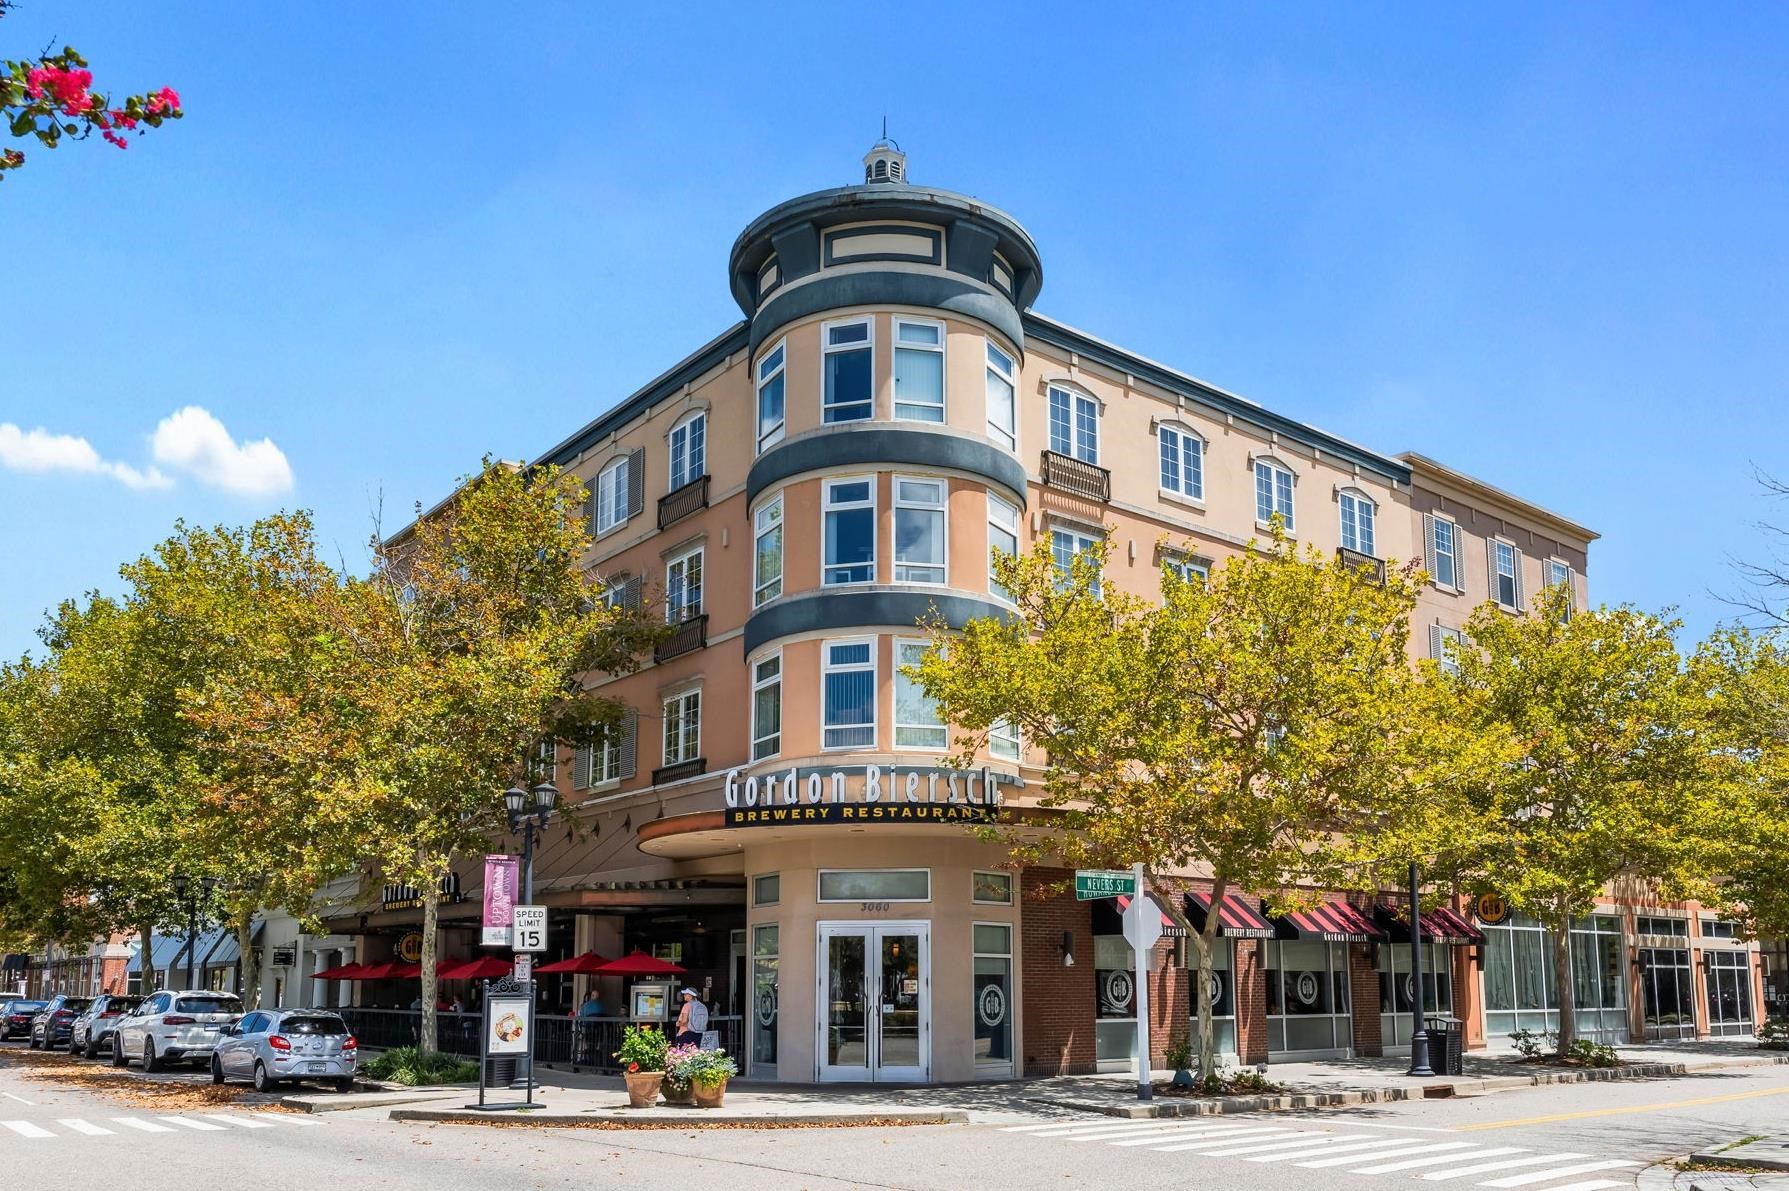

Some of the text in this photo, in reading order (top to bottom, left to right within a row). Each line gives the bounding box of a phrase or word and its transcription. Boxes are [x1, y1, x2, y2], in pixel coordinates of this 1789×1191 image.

[725, 763, 998, 807] Gordon Biersch
[735, 806, 987, 822] BREWERY RESTAURANT
[1087, 878, 1125, 891] NEVERS ST
[492, 866, 504, 924] UPTOWN
[860, 903, 890, 912] 3060
[518, 919, 541, 927] LIMIT
[520, 931, 540, 947] 15
[1224, 927, 1274, 938] BREWERY RESTAURANT
